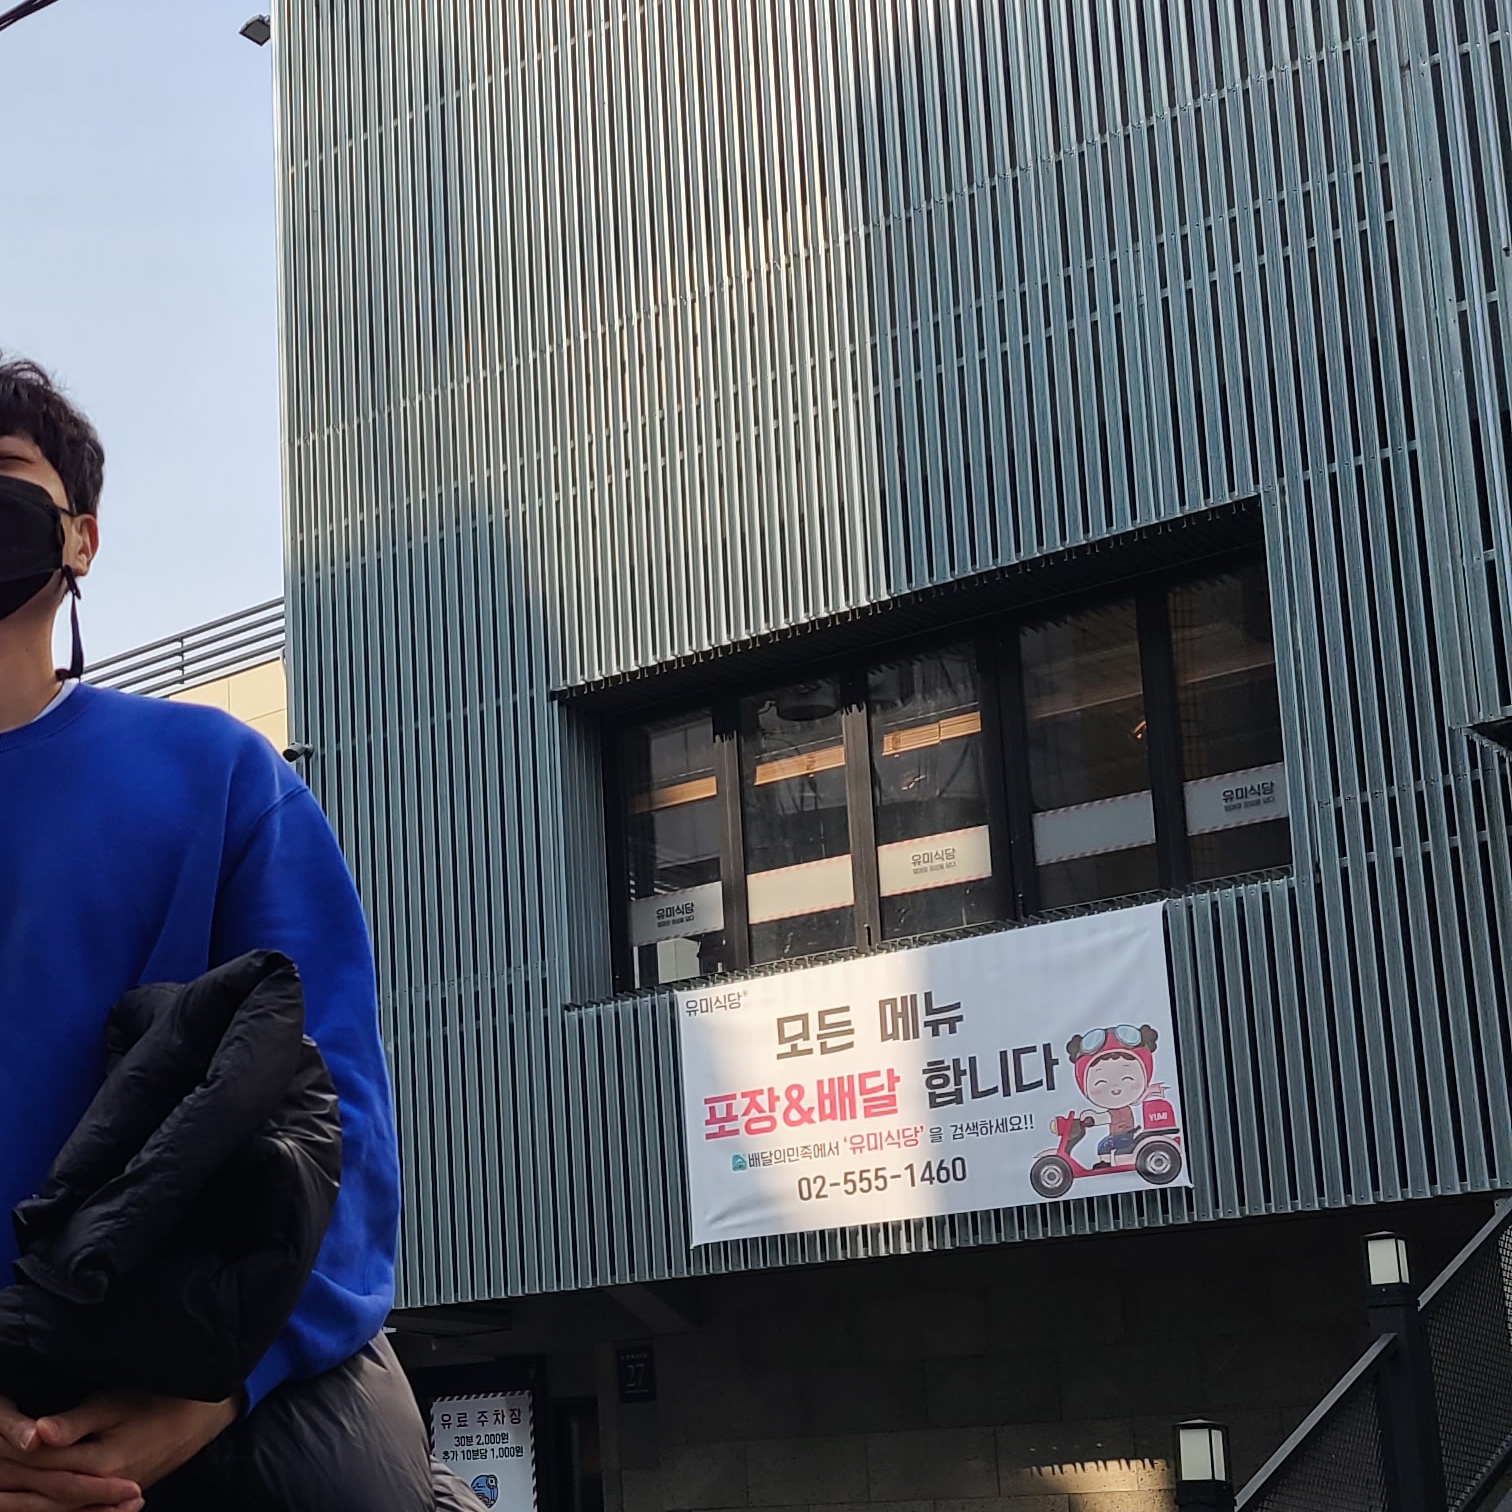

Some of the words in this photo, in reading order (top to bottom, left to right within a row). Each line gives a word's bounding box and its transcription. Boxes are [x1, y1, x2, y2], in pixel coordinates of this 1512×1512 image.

[1222, 781, 1275, 803] 유미식당
[911, 847, 956, 867] 유미식당
[656, 902, 694, 920] 유미식당
[776, 1005, 855, 1060] 모든
[880, 991, 965, 1043] 메뉴
[703, 1067, 901, 1141] 포장&배달
[922, 1042, 1059, 1110] 합니다
[1148, 1111, 1168, 1122] YUMI
[747, 1140, 840, 1170] 배달의민족에서
[951, 1113, 1035, 1142] 검색하세요!!
[797, 1156, 968, 1202] 02-555-1460
[627, 1363, 645, 1387] 27
[440, 1411, 469, 1430] 유료
[476, 1407, 523, 1429] 주차장
[454, 1435, 474, 1447] 30분
[442, 1449, 459, 1462] 추가
[460, 1447, 488, 1461] 10분당
